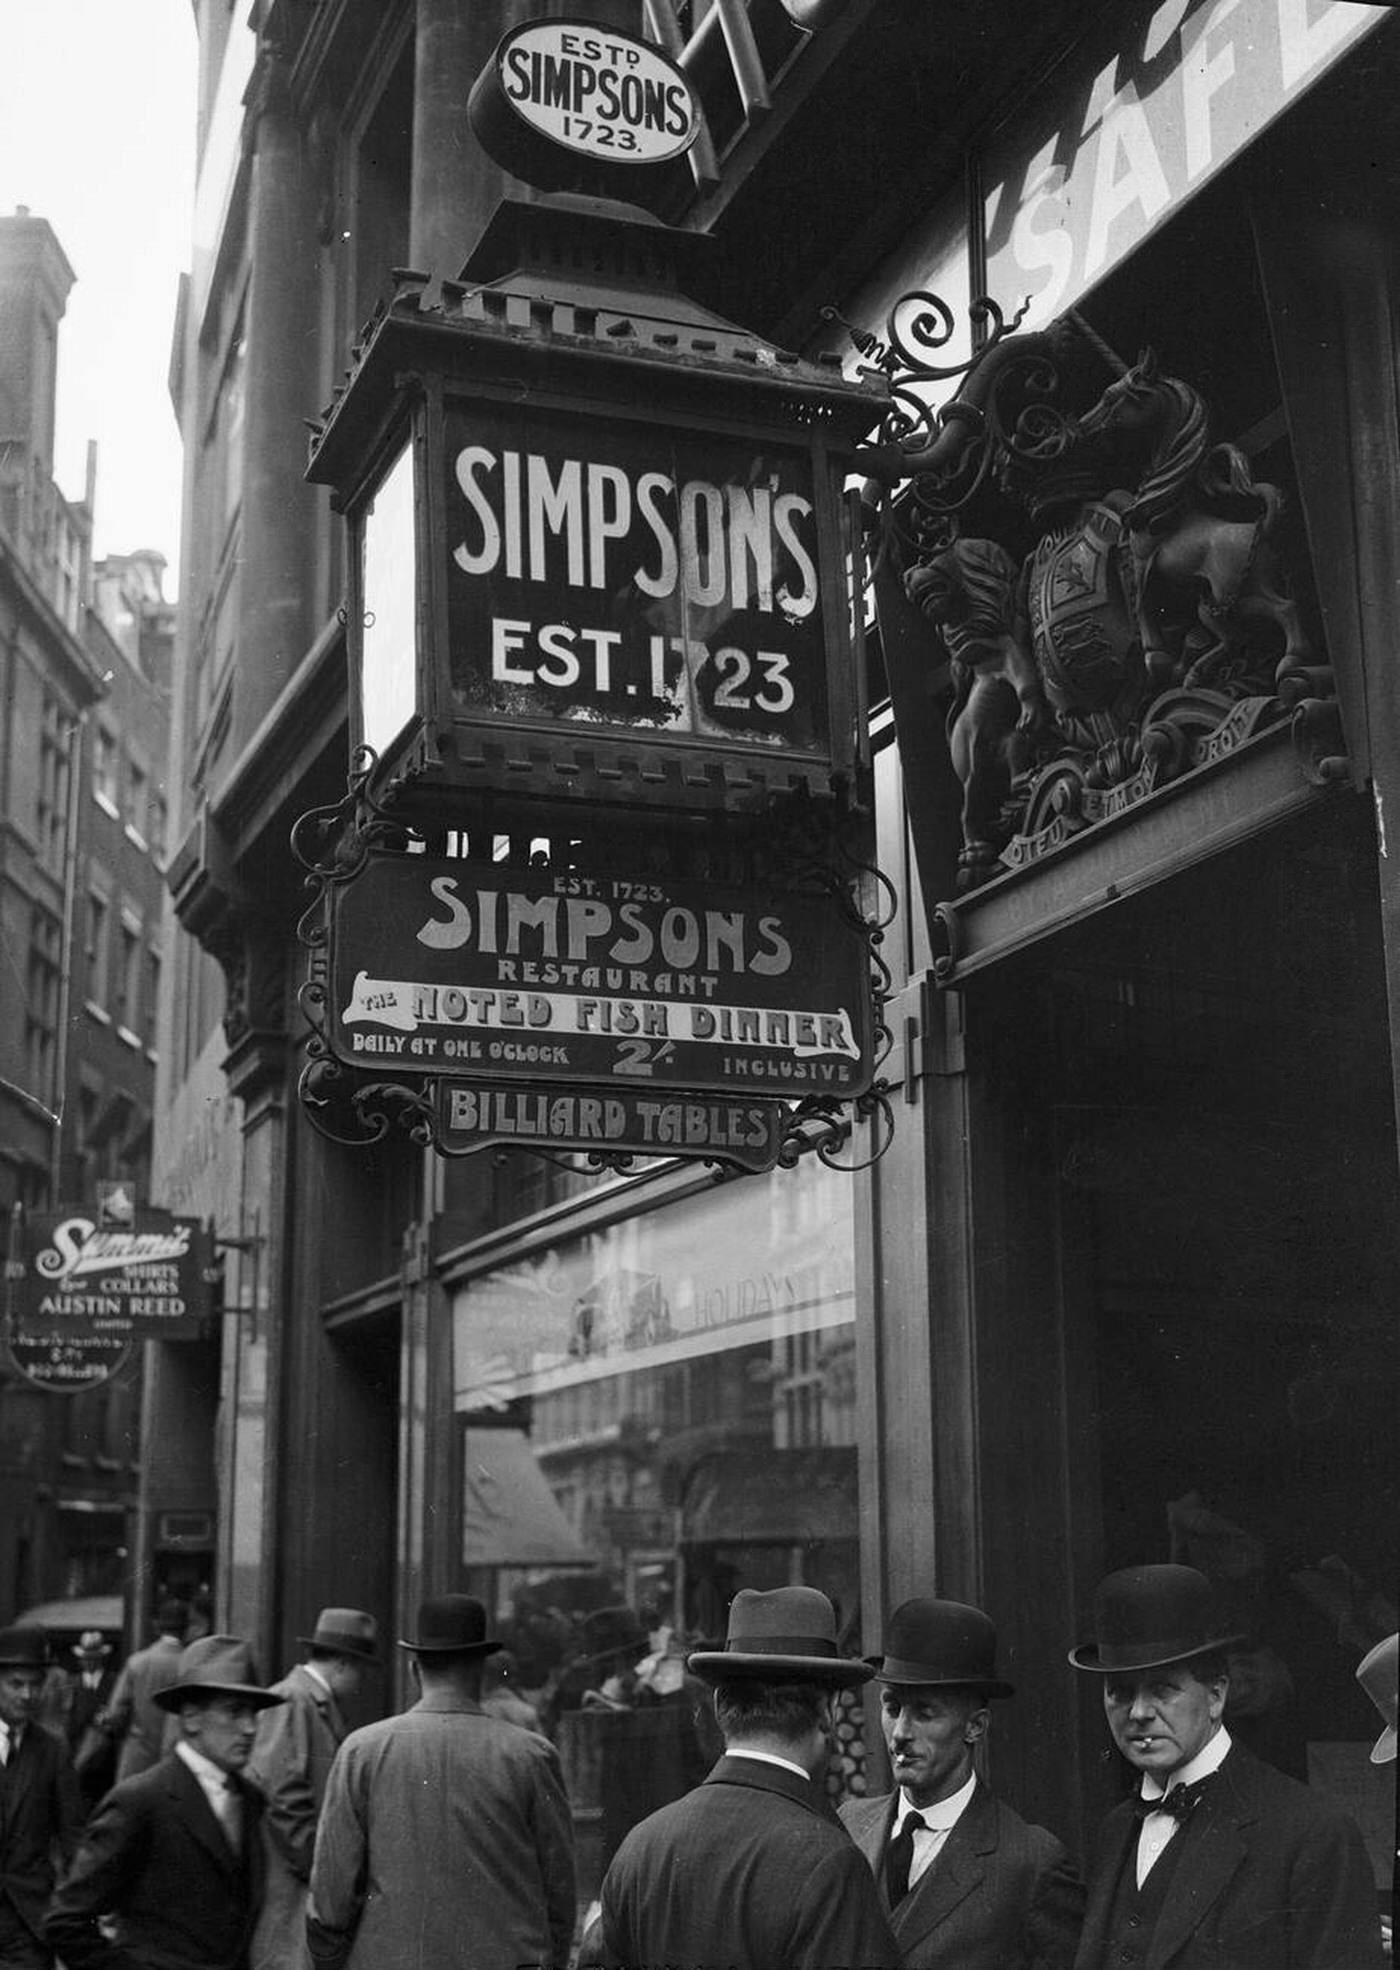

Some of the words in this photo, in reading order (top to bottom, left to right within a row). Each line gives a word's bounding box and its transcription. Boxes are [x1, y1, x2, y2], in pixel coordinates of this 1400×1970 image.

[507, 48, 689, 136] SIMPSONS
[453, 446, 818, 618] SIMPSON'S
[554, 877, 600, 897] EST.
[416, 876, 792, 976] SIMPSONS
[498, 959, 718, 997] RESTAURANT
[361, 991, 398, 1011] THE
[412, 985, 552, 1027] NOTED
[576, 997, 669, 1037] FISH
[690, 1005, 848, 1049] DINNER
[353, 1032, 407, 1053] DAILY
[411, 1036, 438, 1055] AT
[443, 1039, 482, 1058] ONE
[489, 1041, 571, 1065] O'CLOCK
[723, 1057, 850, 1082] INCLUSIVE
[450, 1088, 626, 1139] BILLIARD
[637, 1101, 769, 1148] TABLES
[39, 1295, 122, 1315] AUSTIN
[129, 1297, 187, 1316] REED
[100, 1278, 179, 1295] COLLARS
